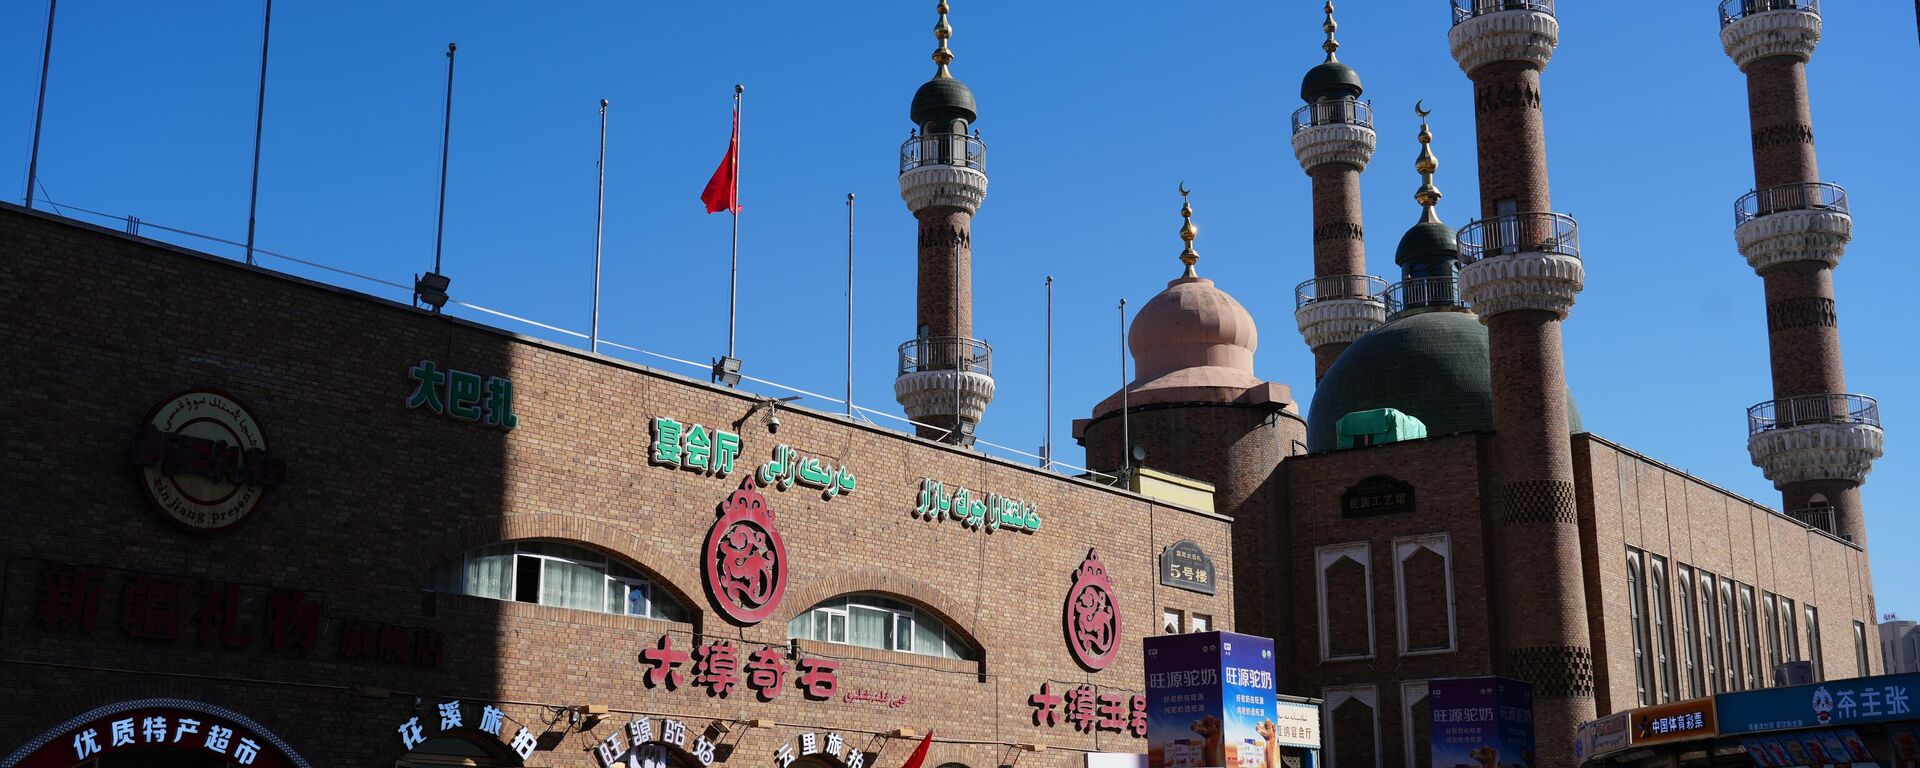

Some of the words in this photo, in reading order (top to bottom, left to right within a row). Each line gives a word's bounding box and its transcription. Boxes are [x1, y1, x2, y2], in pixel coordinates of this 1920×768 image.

[407, 360, 518, 429] 大巴扎
[654, 417, 739, 475] 宴会厅
[917, 478, 951, 518] بازار
[1170, 564, 1207, 583] 5号楼
[35, 562, 318, 653] 新疆礼物
[339, 619, 443, 668] 旗舰店
[644, 633, 840, 698] 大漠奇石
[1149, 668, 1218, 689] 旺源驼奶
[1225, 667, 1273, 690] 旺源驼奶
[1433, 707, 1494, 722] 旺源驼奶
[1836, 685, 1911, 719] 茶主张
[73, 716, 262, 766] 优质特产超市
[398, 700, 537, 760] 花溪旅拍
[1652, 712, 1704, 734] 中国体育彩票
[777, 732, 865, 768] 云里旅拍
